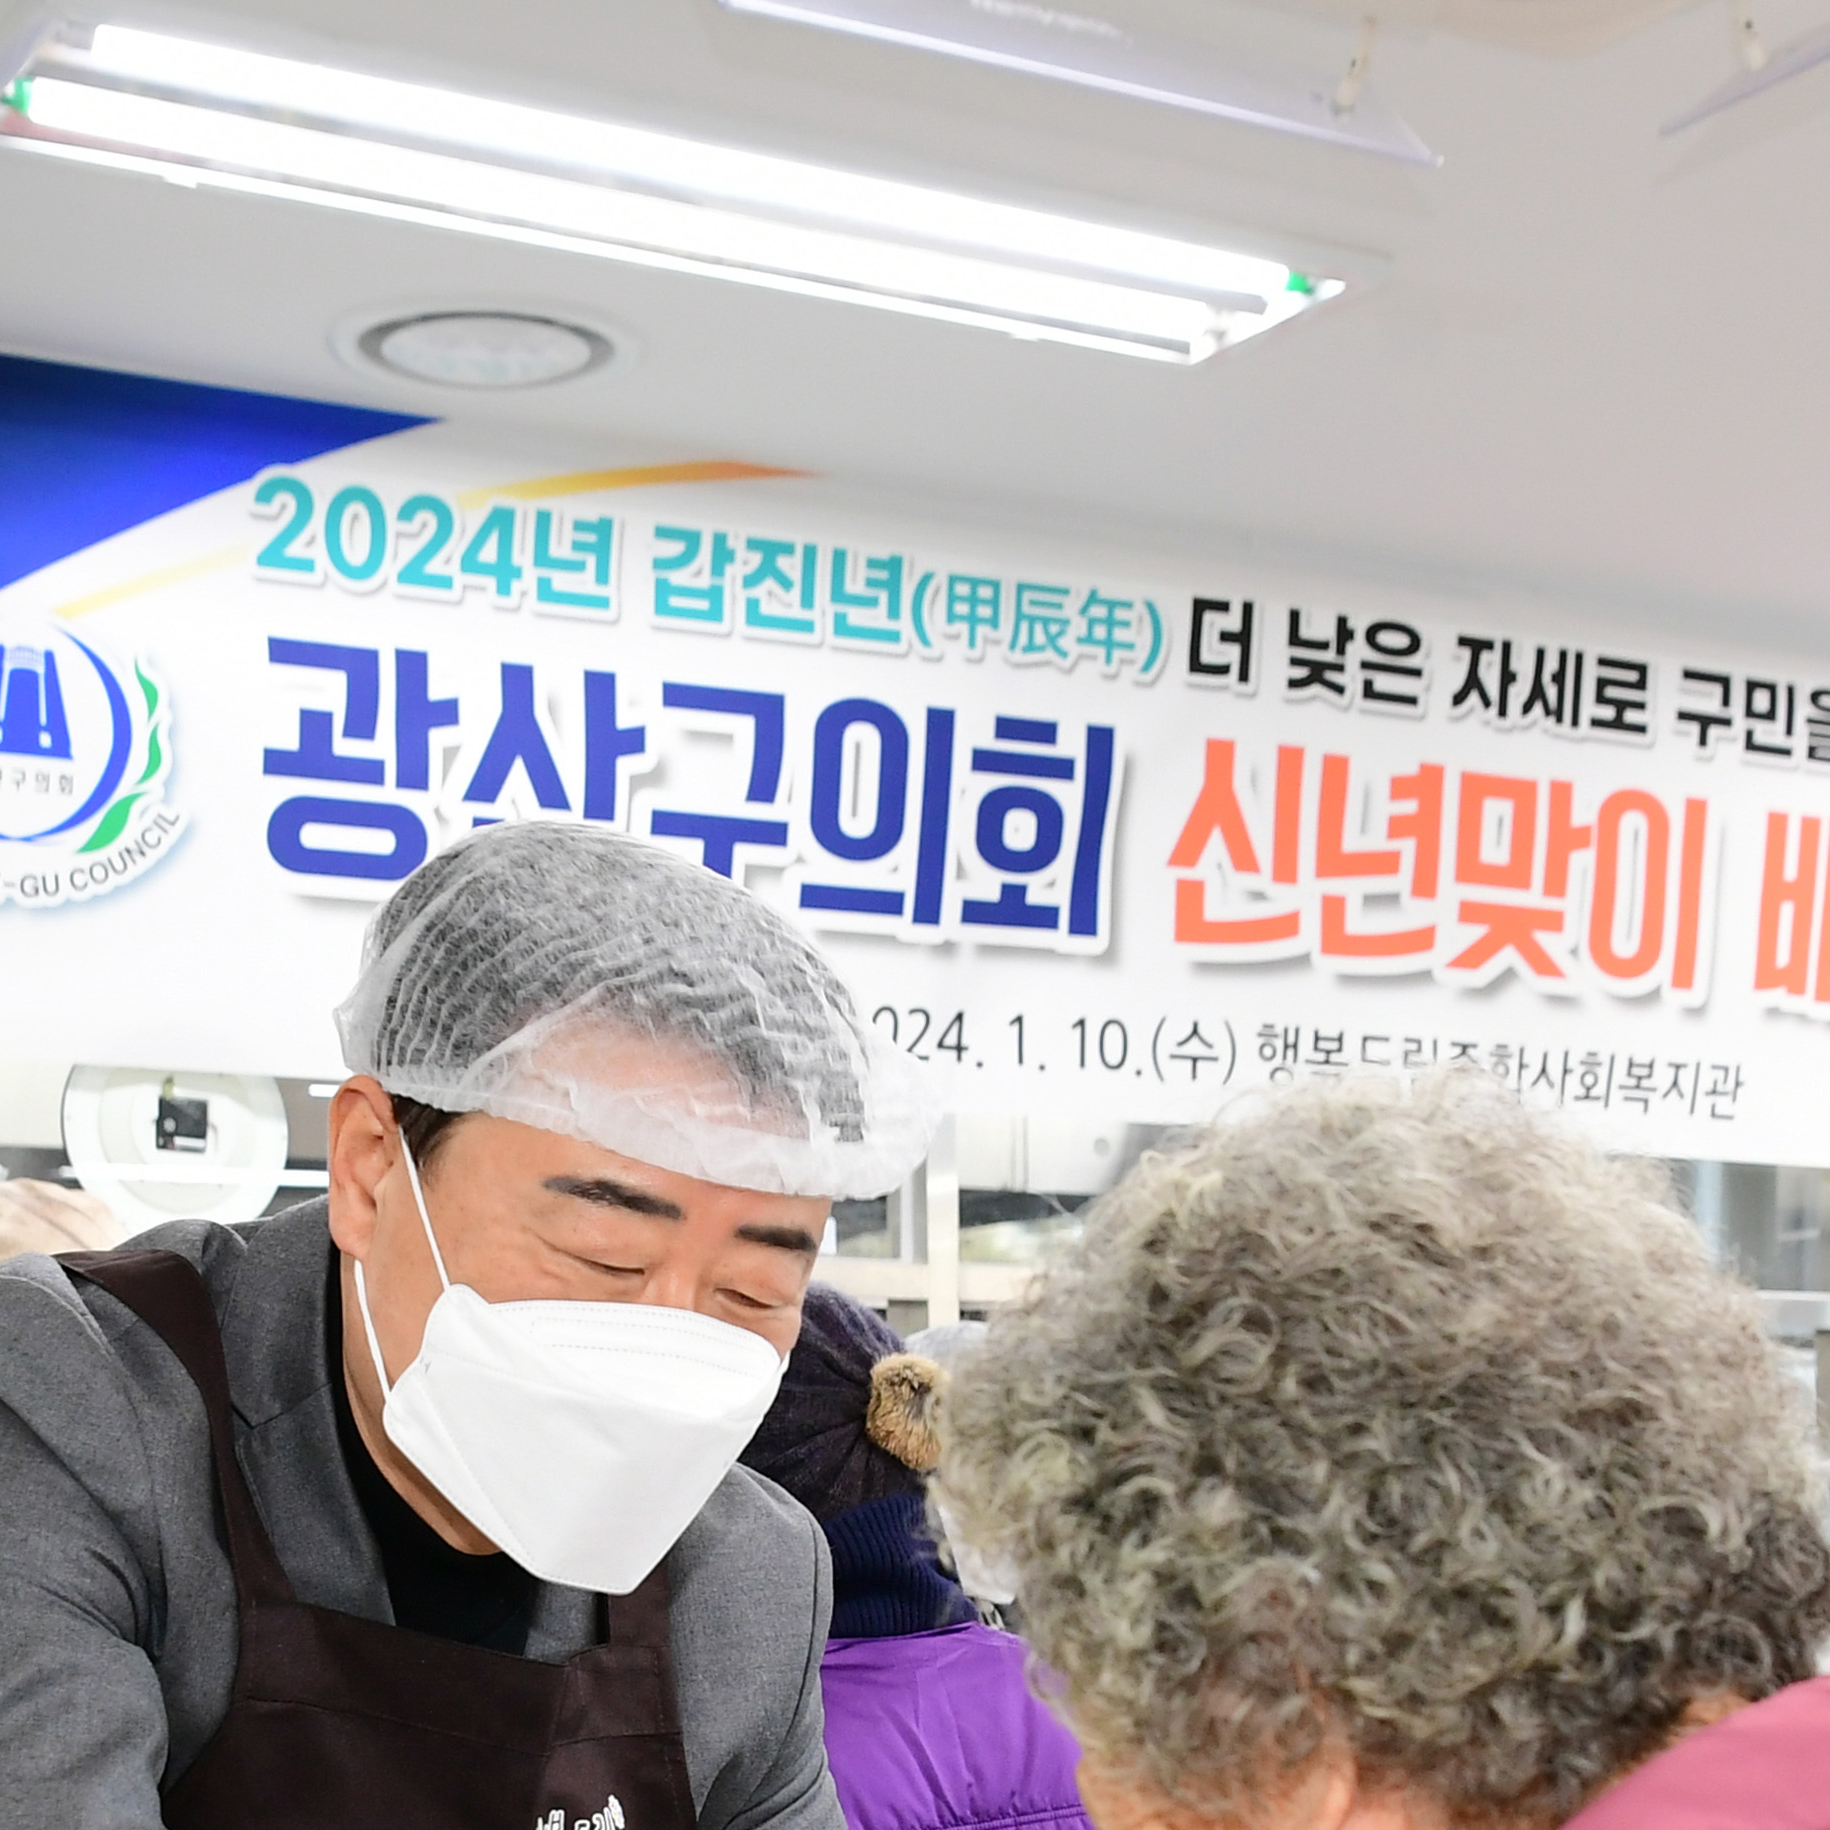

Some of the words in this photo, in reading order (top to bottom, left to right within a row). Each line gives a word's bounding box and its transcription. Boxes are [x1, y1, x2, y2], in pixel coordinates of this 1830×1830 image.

[254, 475, 614, 611] 2024년
[652, 524, 1164, 675] 갑진년(甲辰年)
[1188, 597, 1254, 684] 더
[1287, 608, 1424, 707] 낮은
[1451, 634, 1649, 735] 자세로
[69, 809, 181, 892] COUNCIL
[263, 635, 1115, 937] 광산구의회
[1166, 737, 1709, 990] 신년맞이
[872, 1005, 984, 1069] 024.
[1009, 1015, 1047, 1073] 1.
[1071, 1014, 1237, 1086] 10.(수)
